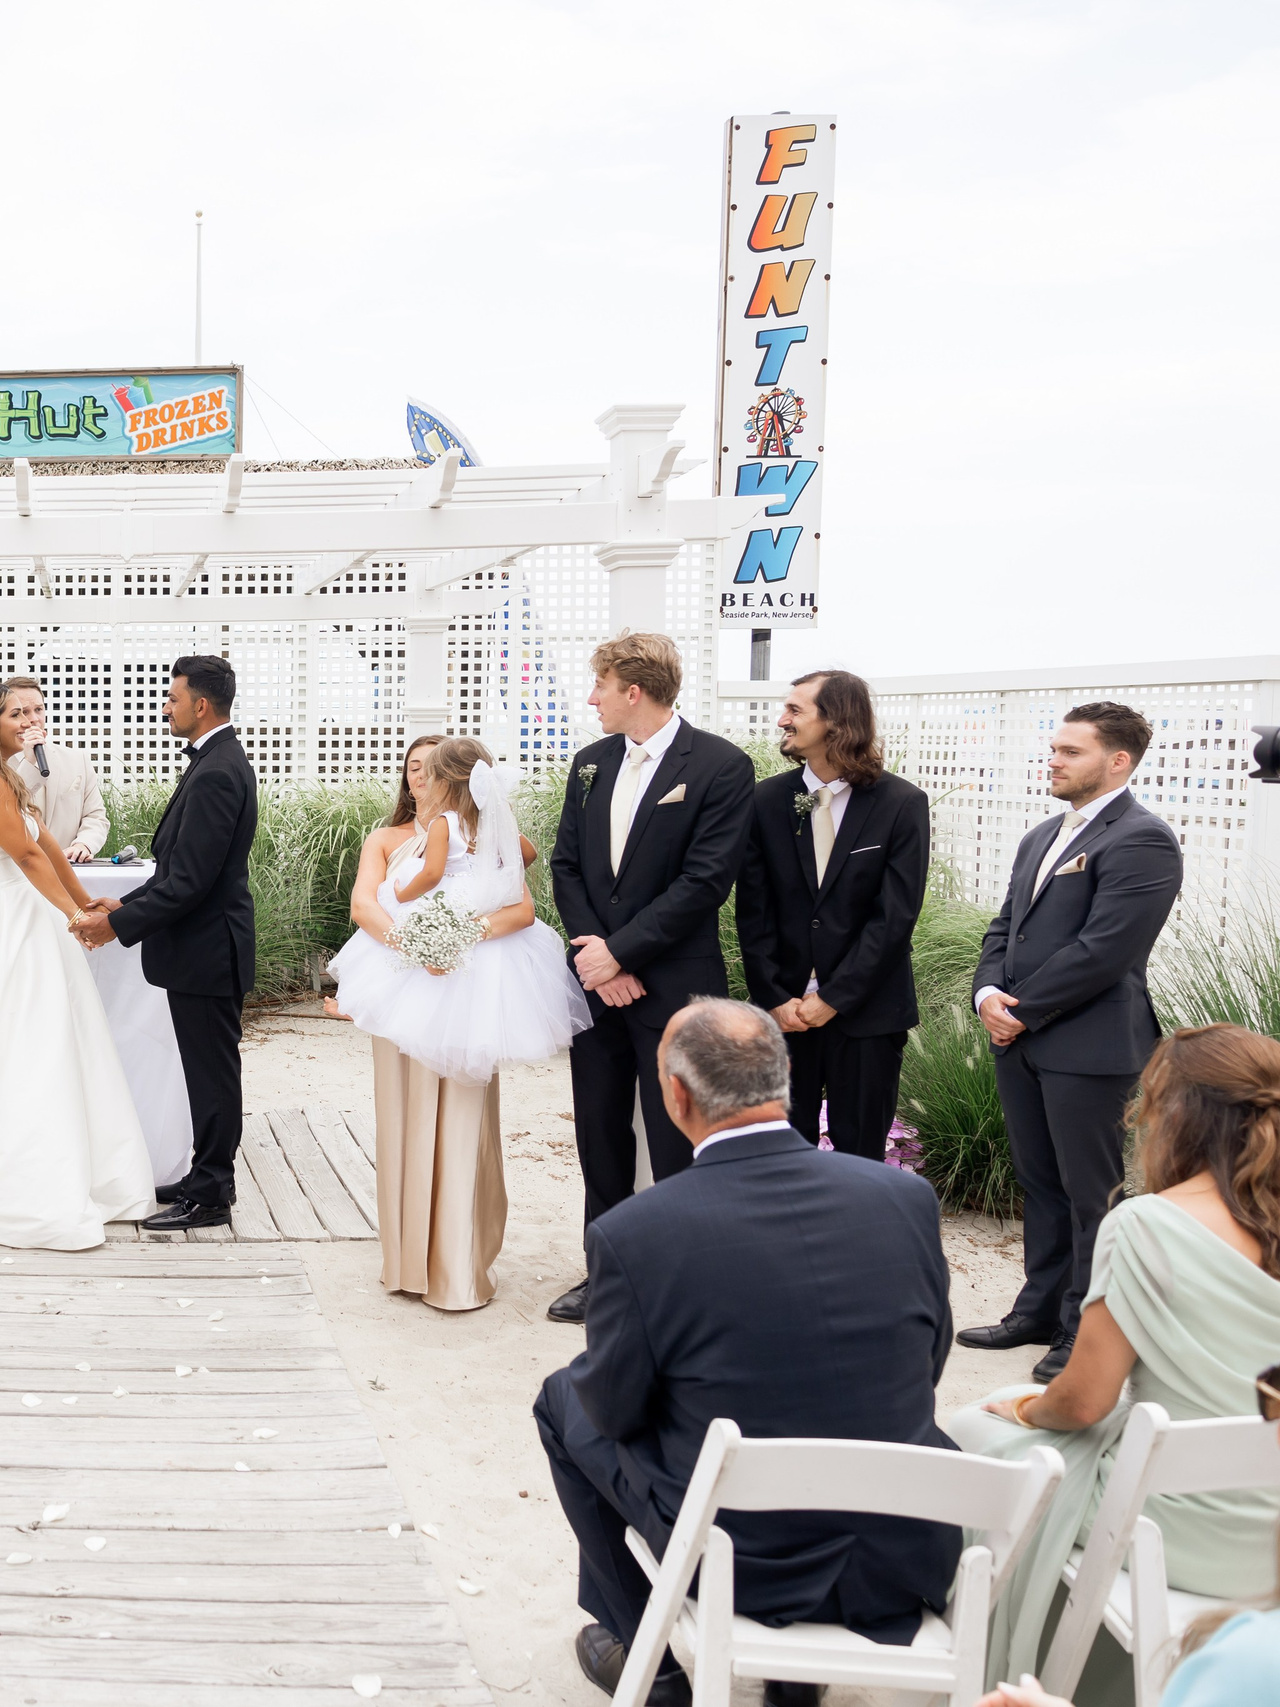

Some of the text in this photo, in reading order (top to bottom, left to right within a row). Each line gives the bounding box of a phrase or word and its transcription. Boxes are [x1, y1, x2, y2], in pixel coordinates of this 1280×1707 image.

[128, 389, 225, 433] FROZEN
[135, 410, 229, 453] DRINKS
[721, 592, 815, 607] BEACH
[720, 611, 815, 620] Seaside Park, New Jersey
